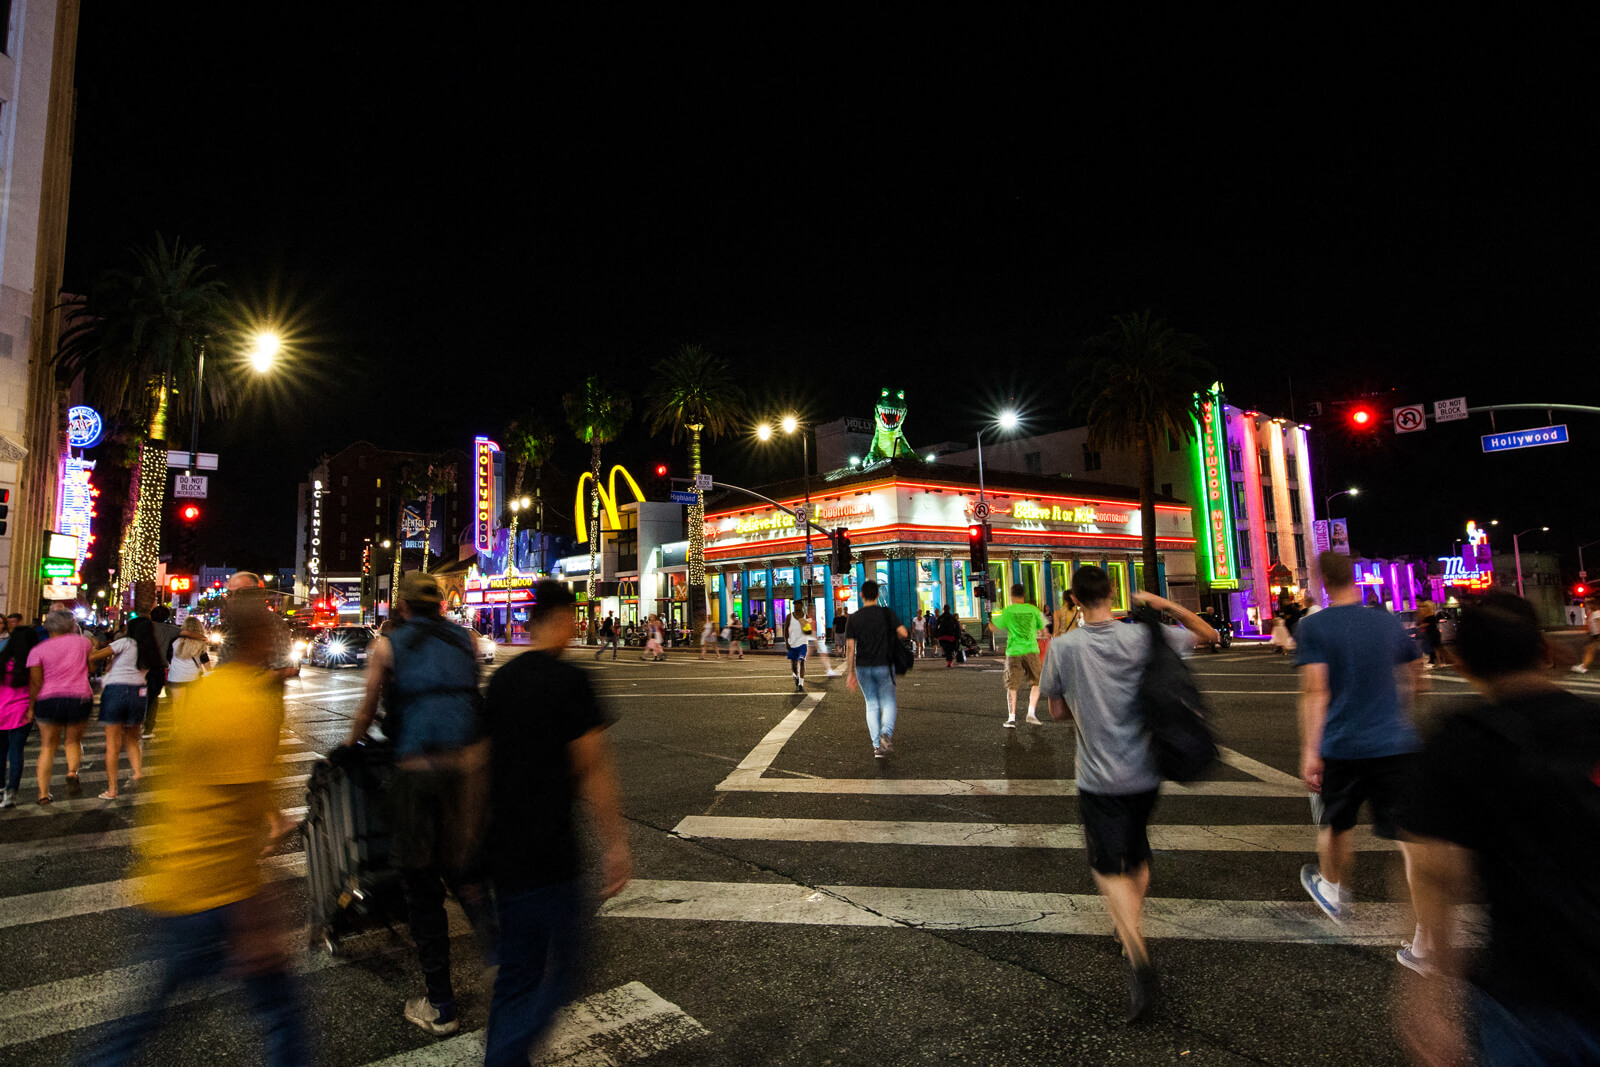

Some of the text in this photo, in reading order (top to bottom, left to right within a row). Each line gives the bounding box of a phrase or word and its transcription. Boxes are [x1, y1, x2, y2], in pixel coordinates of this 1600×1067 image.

[1440, 407, 1461, 415] BLOCK
[847, 418, 873, 430] HOLLY
[1491, 430, 1558, 448] Hollywood
[191, 477, 203, 485] NOT
[1203, 401, 1229, 576] HOLLYWOOD MUSEUM
[479, 445, 488, 543] HOLLYWOOD
[670, 493, 697, 502] Highland
[1013, 502, 1051, 519] Believe
[1051, 505, 1062, 521] It
[1062, 510, 1074, 522] or
[736, 516, 769, 534] Believe
[405, 541, 425, 549] DIRECT
